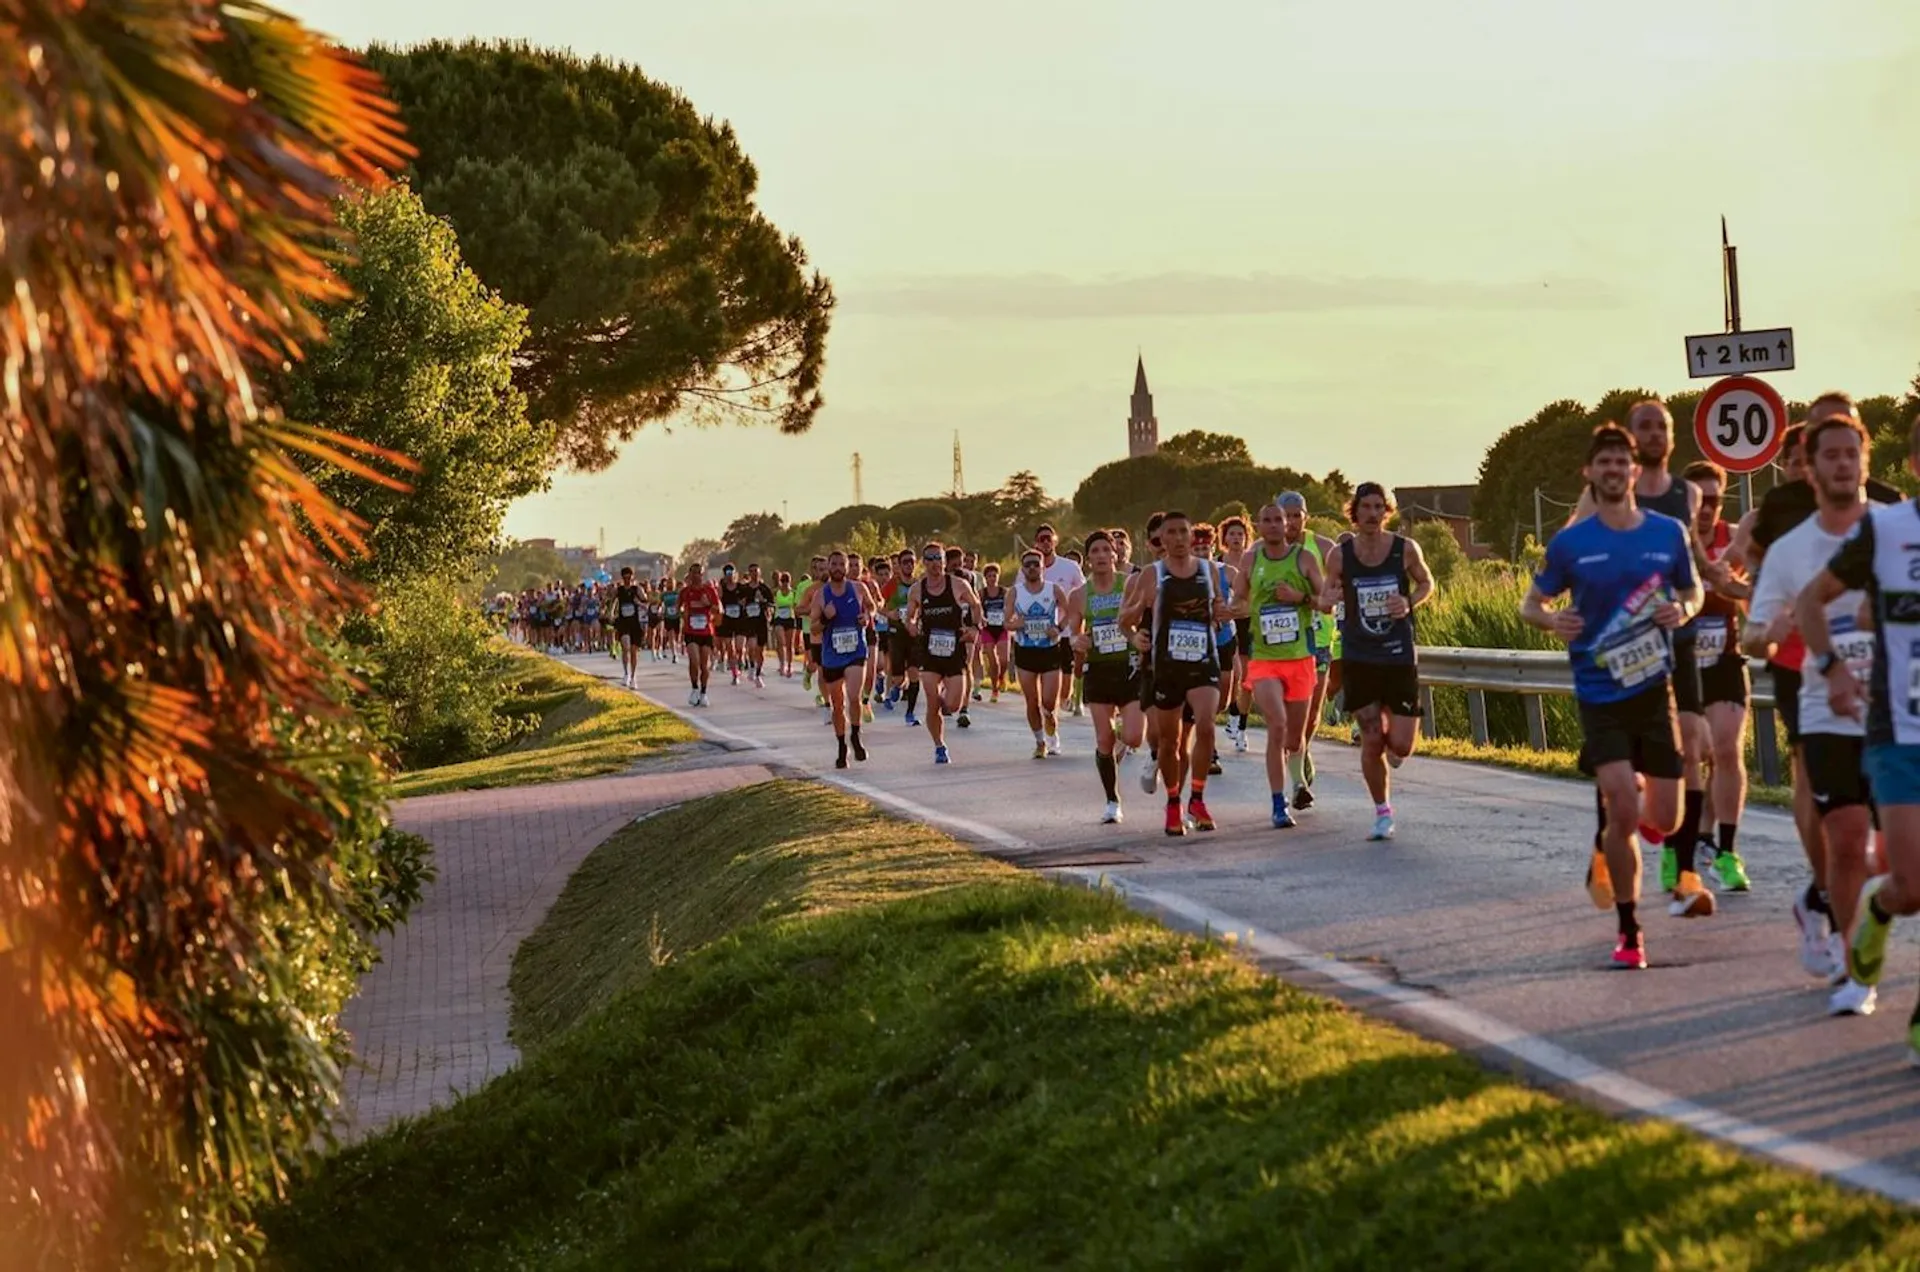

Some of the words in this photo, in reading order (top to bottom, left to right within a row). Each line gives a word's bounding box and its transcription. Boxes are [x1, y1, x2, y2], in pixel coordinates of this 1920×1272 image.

[1717, 345, 1731, 364] 2
[1739, 343, 1769, 363] km
[1717, 403, 1768, 447] 50
[1269, 617, 1291, 630] 1423
